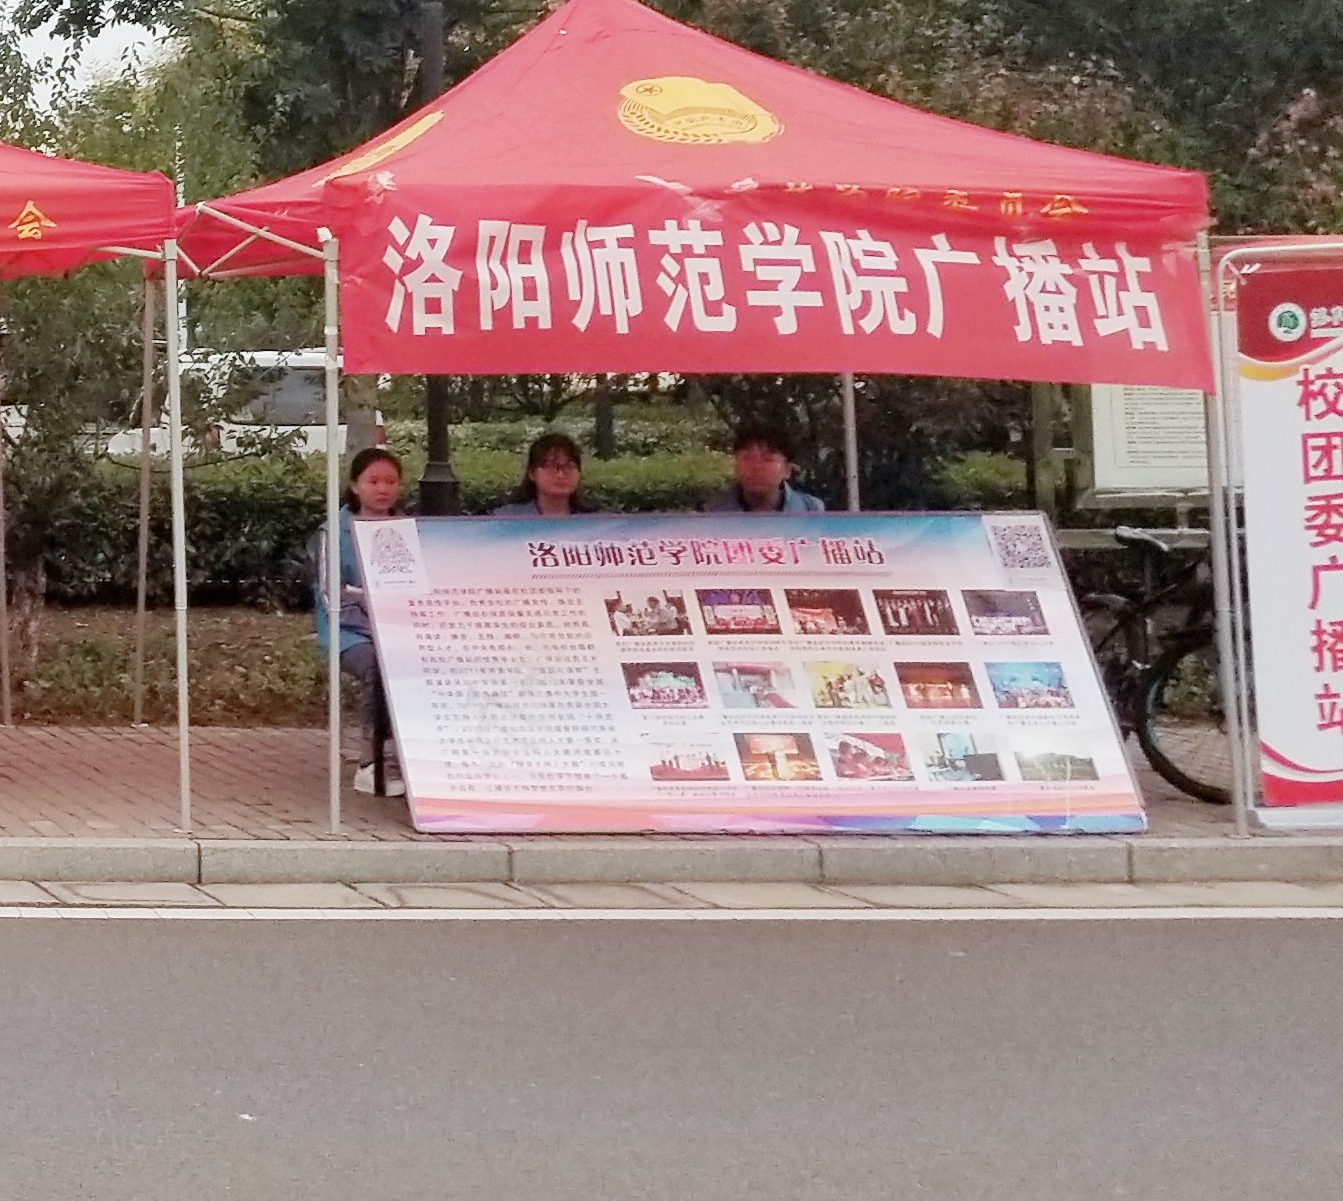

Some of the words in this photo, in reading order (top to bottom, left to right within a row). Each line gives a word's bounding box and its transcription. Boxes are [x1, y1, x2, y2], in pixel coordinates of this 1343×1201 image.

[382, 215, 1170, 352] 洛阳师范学院广播站
[527, 538, 886, 568] 洛阳师范学院团委广播站
[1297, 367, 1343, 733] 校团委广播站
